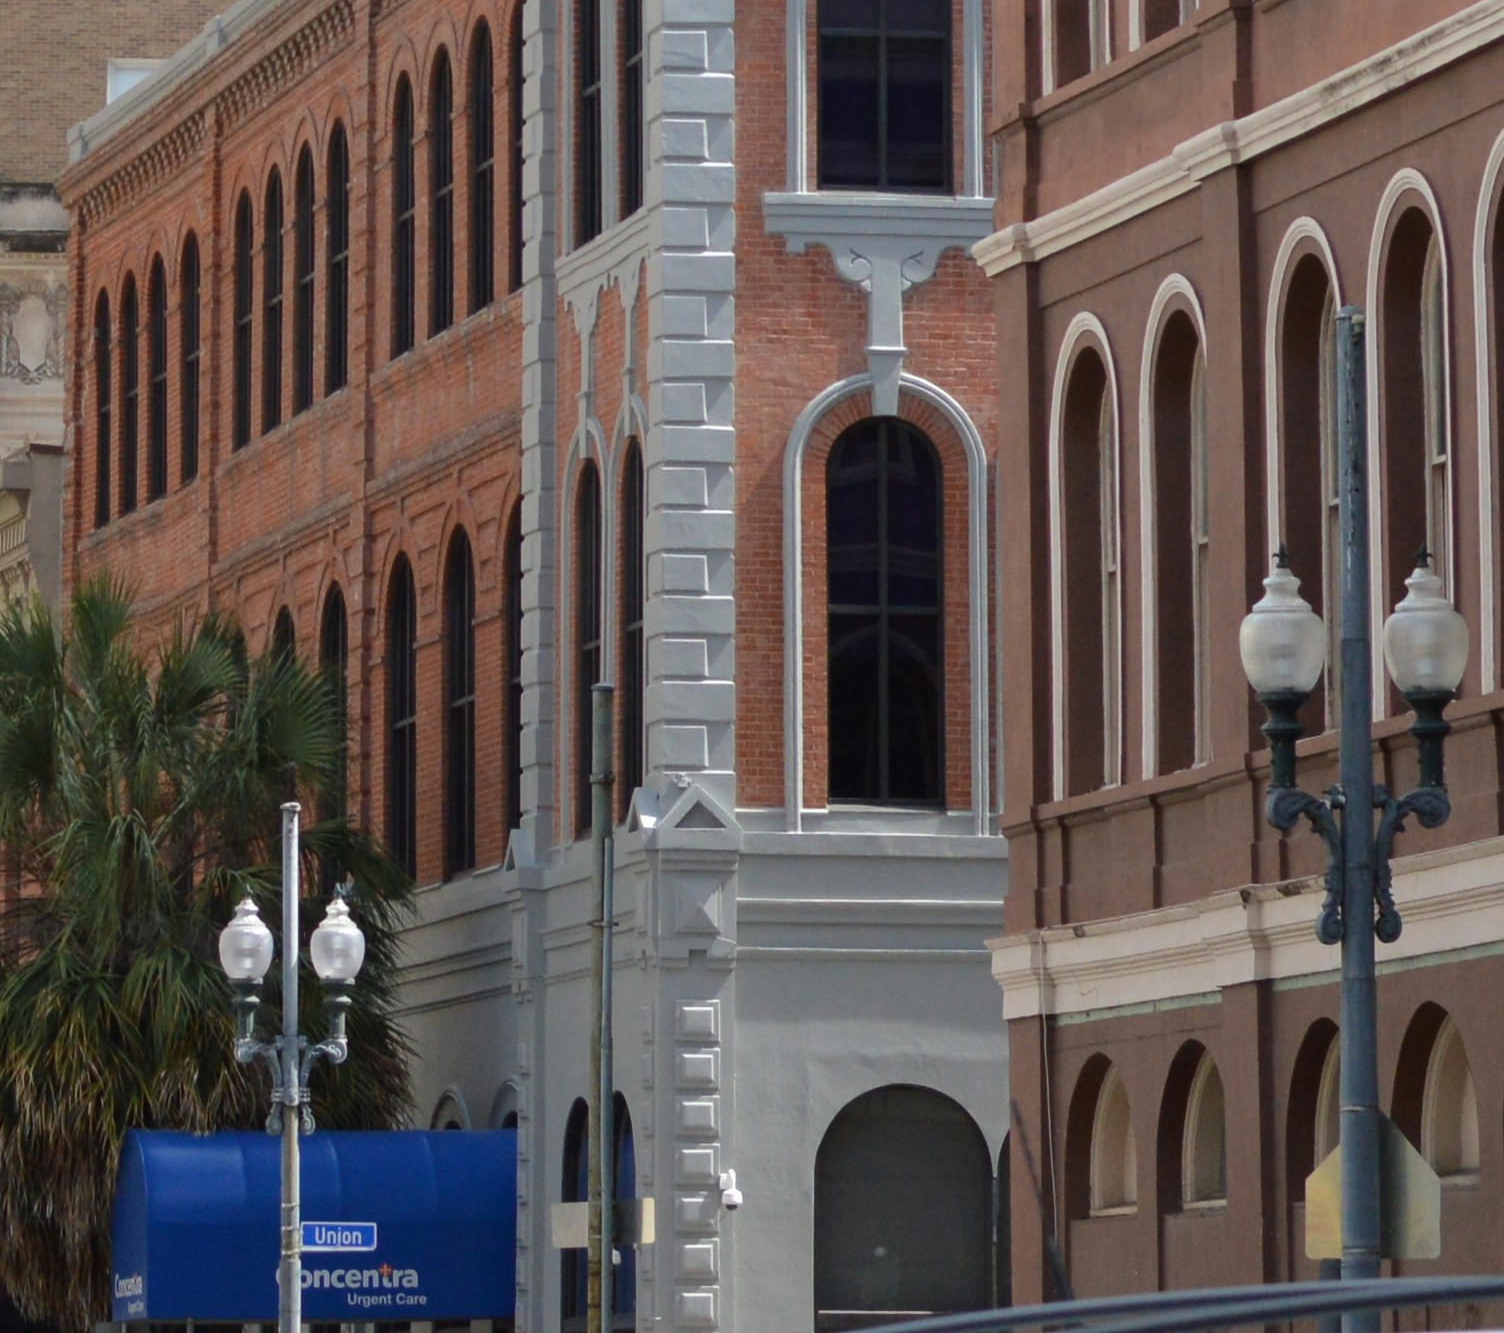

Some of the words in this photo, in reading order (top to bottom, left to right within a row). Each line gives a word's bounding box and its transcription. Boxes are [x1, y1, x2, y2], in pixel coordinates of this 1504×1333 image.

[314, 1227, 362, 1245] Union
[347, 1293, 392, 1307] Urgent
[395, 1293, 427, 1305] Care
